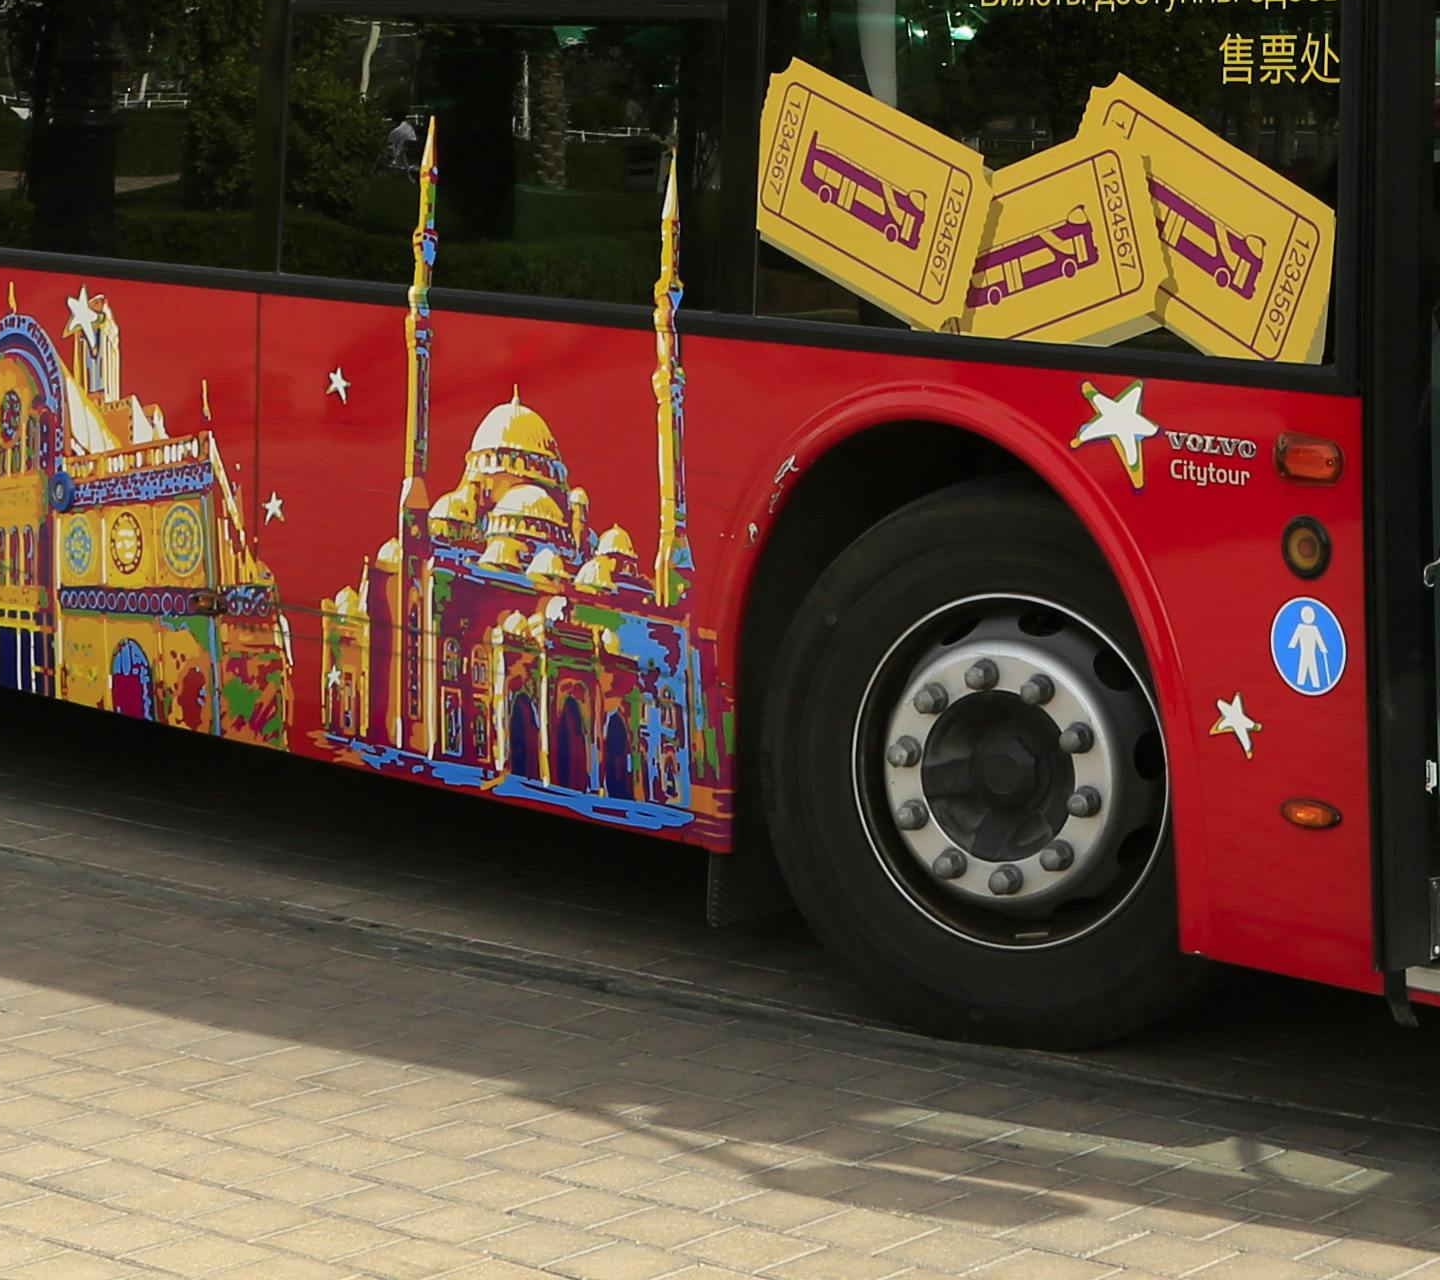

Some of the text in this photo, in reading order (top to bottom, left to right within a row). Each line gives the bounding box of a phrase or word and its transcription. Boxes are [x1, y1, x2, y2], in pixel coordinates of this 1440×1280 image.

[1219, 32, 1341, 85] 售票处
[769, 100, 801, 196] 1234567
[930, 187, 964, 287] 1234567
[1102, 168, 1136, 270] 1234567
[1265, 238, 1311, 342] 1234567
[1165, 430, 1256, 458] VOLVO
[1170, 459, 1250, 487] Citytour
